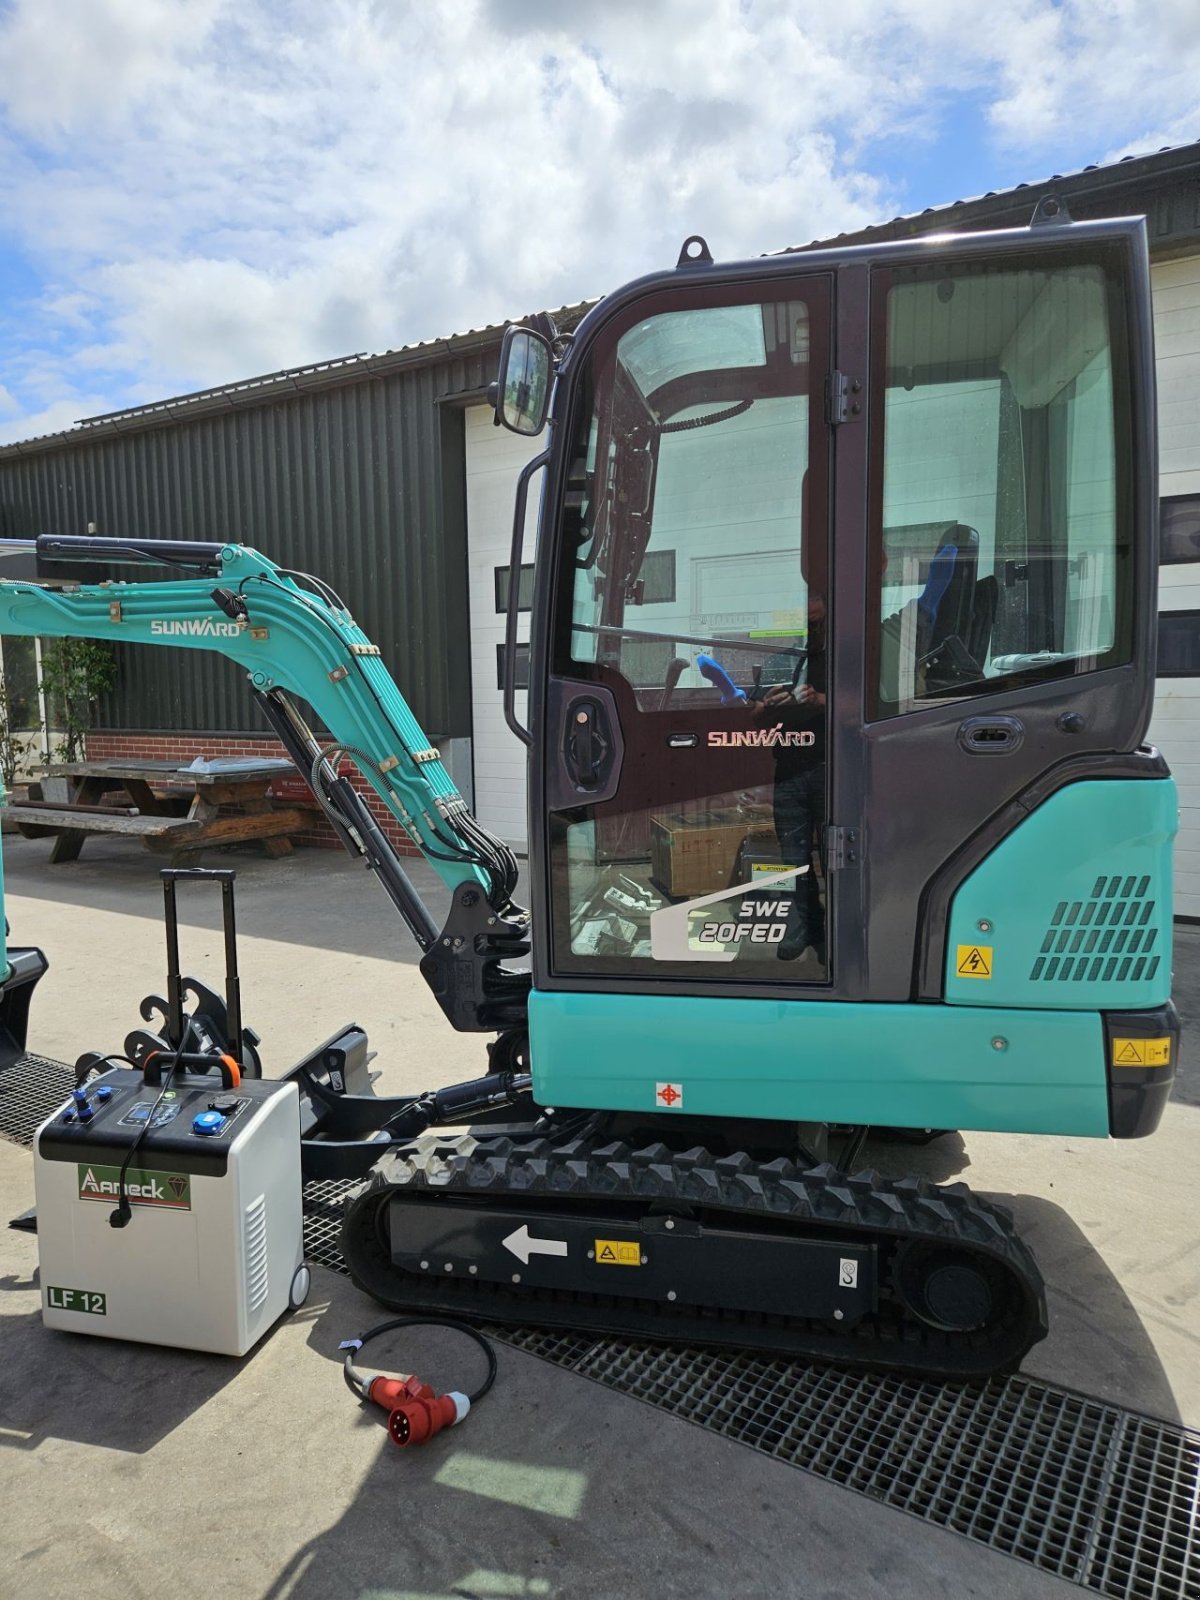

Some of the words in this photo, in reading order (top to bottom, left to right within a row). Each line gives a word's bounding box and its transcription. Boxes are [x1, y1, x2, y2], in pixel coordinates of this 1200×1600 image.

[150, 616, 240, 637] SUNWARD
[707, 722, 816, 747] SUNWARD
[739, 901, 792, 917] SWE
[699, 922, 788, 943] 20FED
[50, 1288, 74, 1307] LF
[81, 1293, 104, 1313] 12
